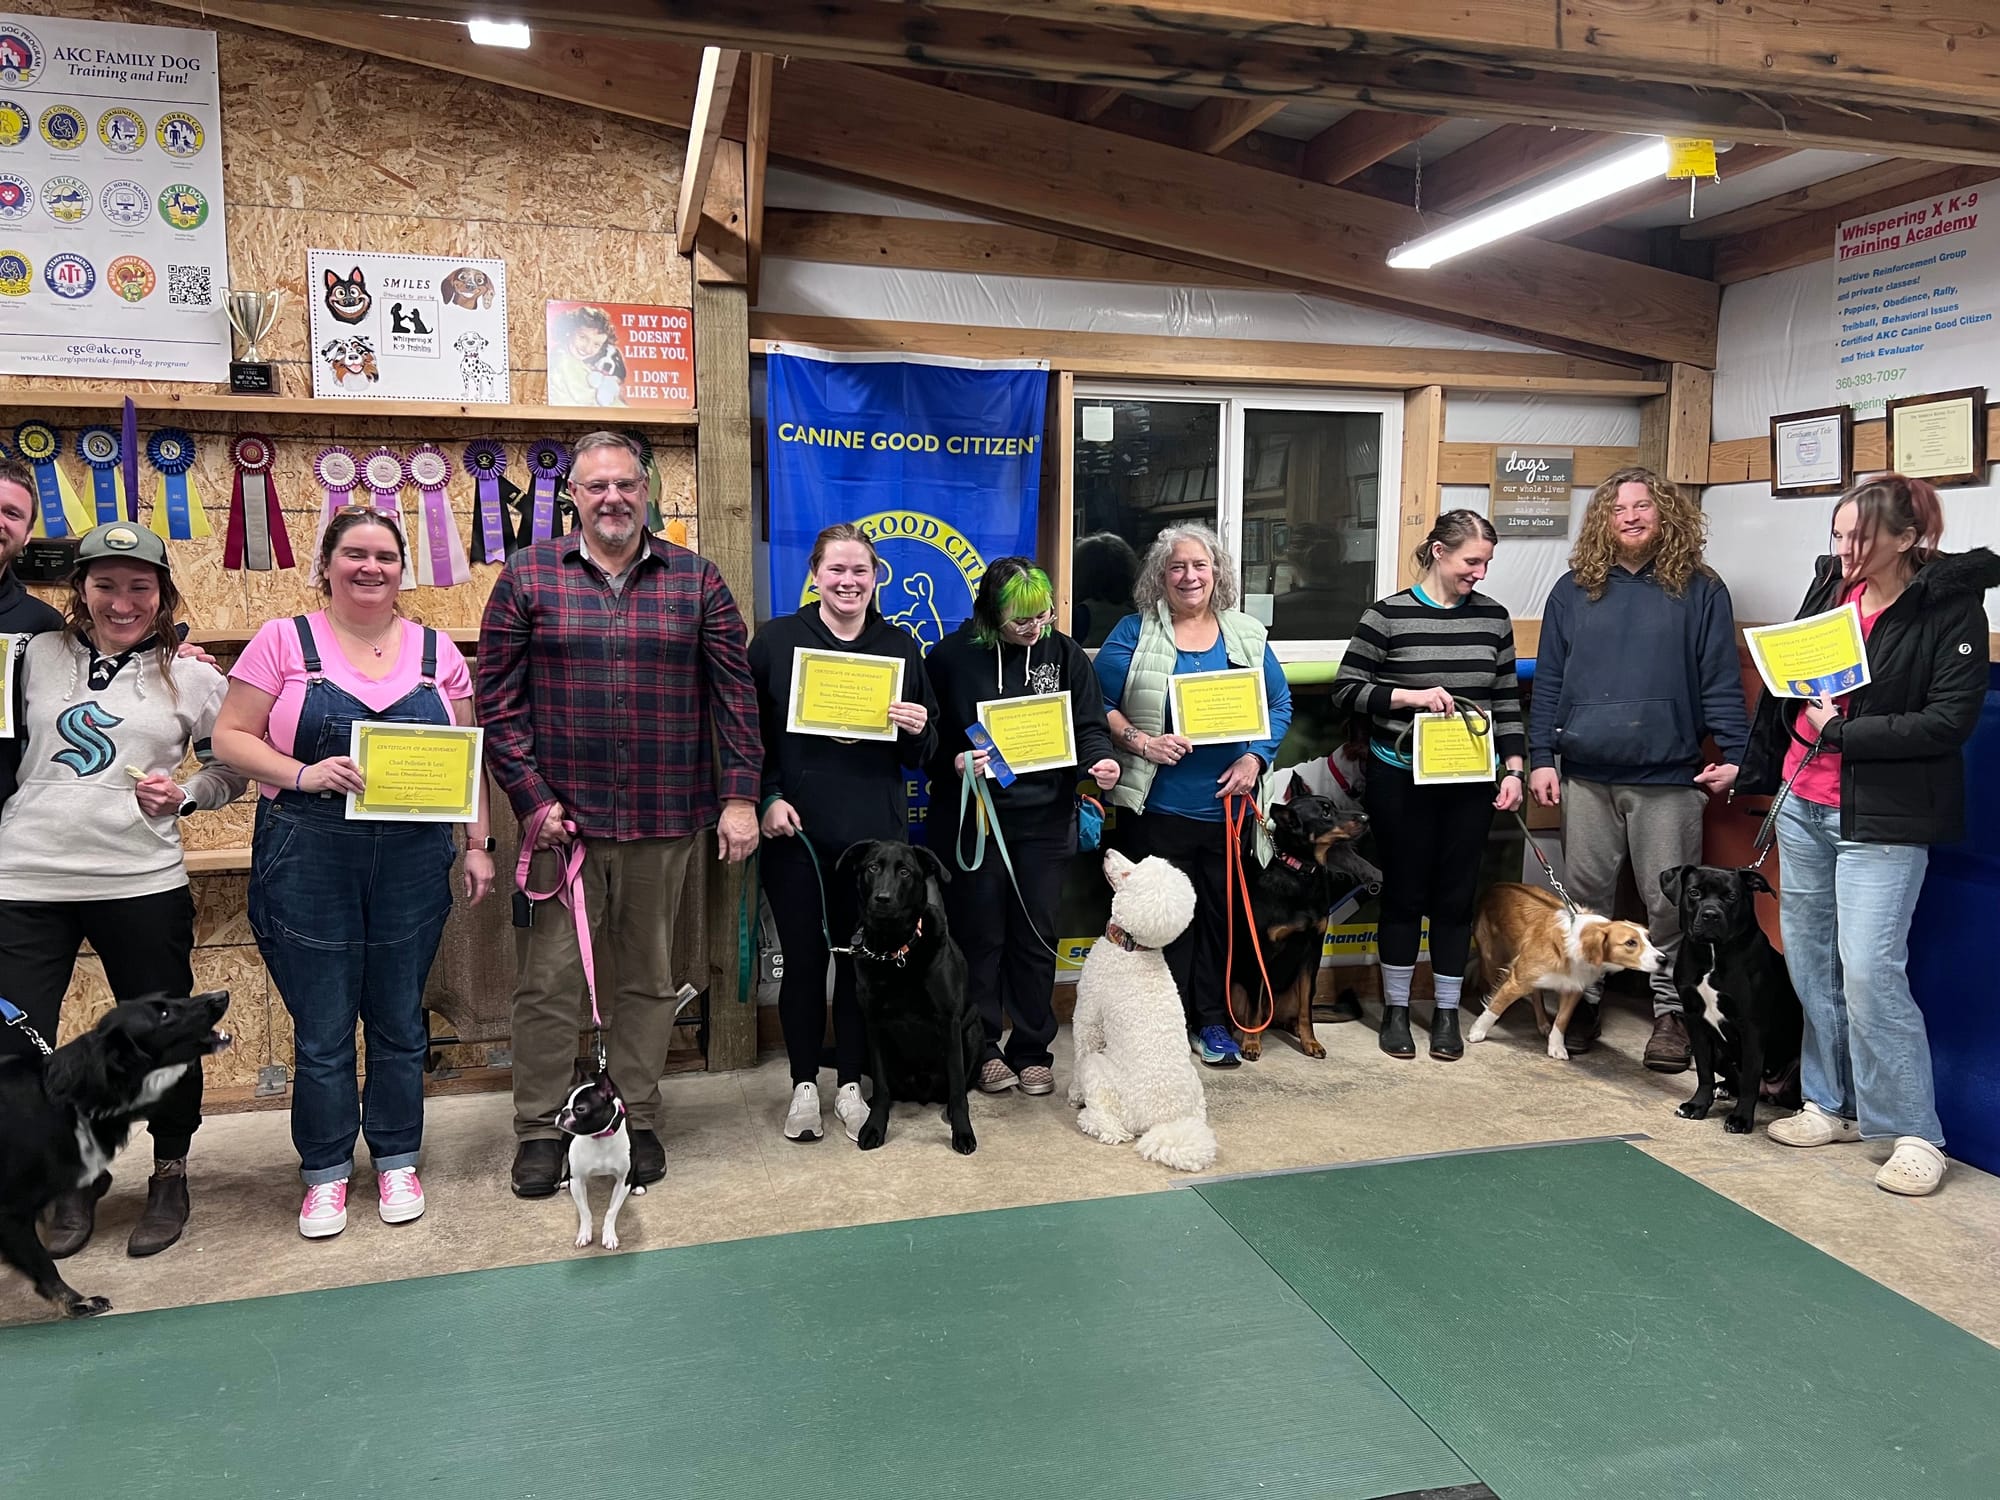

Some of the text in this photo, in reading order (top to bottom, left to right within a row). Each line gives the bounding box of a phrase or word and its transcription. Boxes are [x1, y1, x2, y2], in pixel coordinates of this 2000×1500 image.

[1, 26, 20, 35] DOG
[53, 47, 200, 71] AKC FAMILY DOG
[67, 63, 188, 84] Training and Fun!
[52, 106, 72, 114] GOOD
[166, 114, 191, 123] URBAN
[42, 177, 91, 202] AKC TRICK DOG
[112, 181, 132, 189] HOME
[23, 185, 33, 204] DOG
[160, 185, 206, 205] AKC FIT DOG
[1842, 192, 1978, 242] Whispering X K-9
[1839, 213, 1978, 261] Training Academy
[1838, 249, 1967, 285] Positive Reinforcement Group
[383, 278, 431, 290] SMILES
[1851, 285, 1883, 299] private
[1885, 276, 1920, 291] classes!
[1843, 286, 1958, 316] Puppies, Obedience, Rally,
[622, 314, 687, 329] IF MY DOG
[1881, 308, 1929, 325] Behavioral
[1930, 302, 1960, 316] Issues
[629, 330, 682, 344] DOESN'T
[1840, 312, 1993, 348] Certified AKC Canine Good Citizen
[392, 335, 427, 344] Whispering
[67, 344, 141, 358] cgc@akc.org
[407, 344, 431, 353] Training
[625, 346, 689, 362] LIKE YOU,
[1840, 342, 1925, 364] and Trick Evaluator
[634, 371, 680, 385] I DON'T
[1835, 368, 1907, 390] 360-393-7097
[626, 386, 690, 400] LIKE YOU.
[778, 422, 865, 449] CANINE
[870, 431, 940, 452] GOOD
[1505, 450, 1550, 483] dogs
[1552, 474, 1566, 482] not
[1520, 485, 1542, 493] whole
[1544, 485, 1566, 493] lives
[1517, 495, 1551, 505] but they
[859, 515, 940, 540] GOOD
[1508, 518, 1554, 526] lives whole
